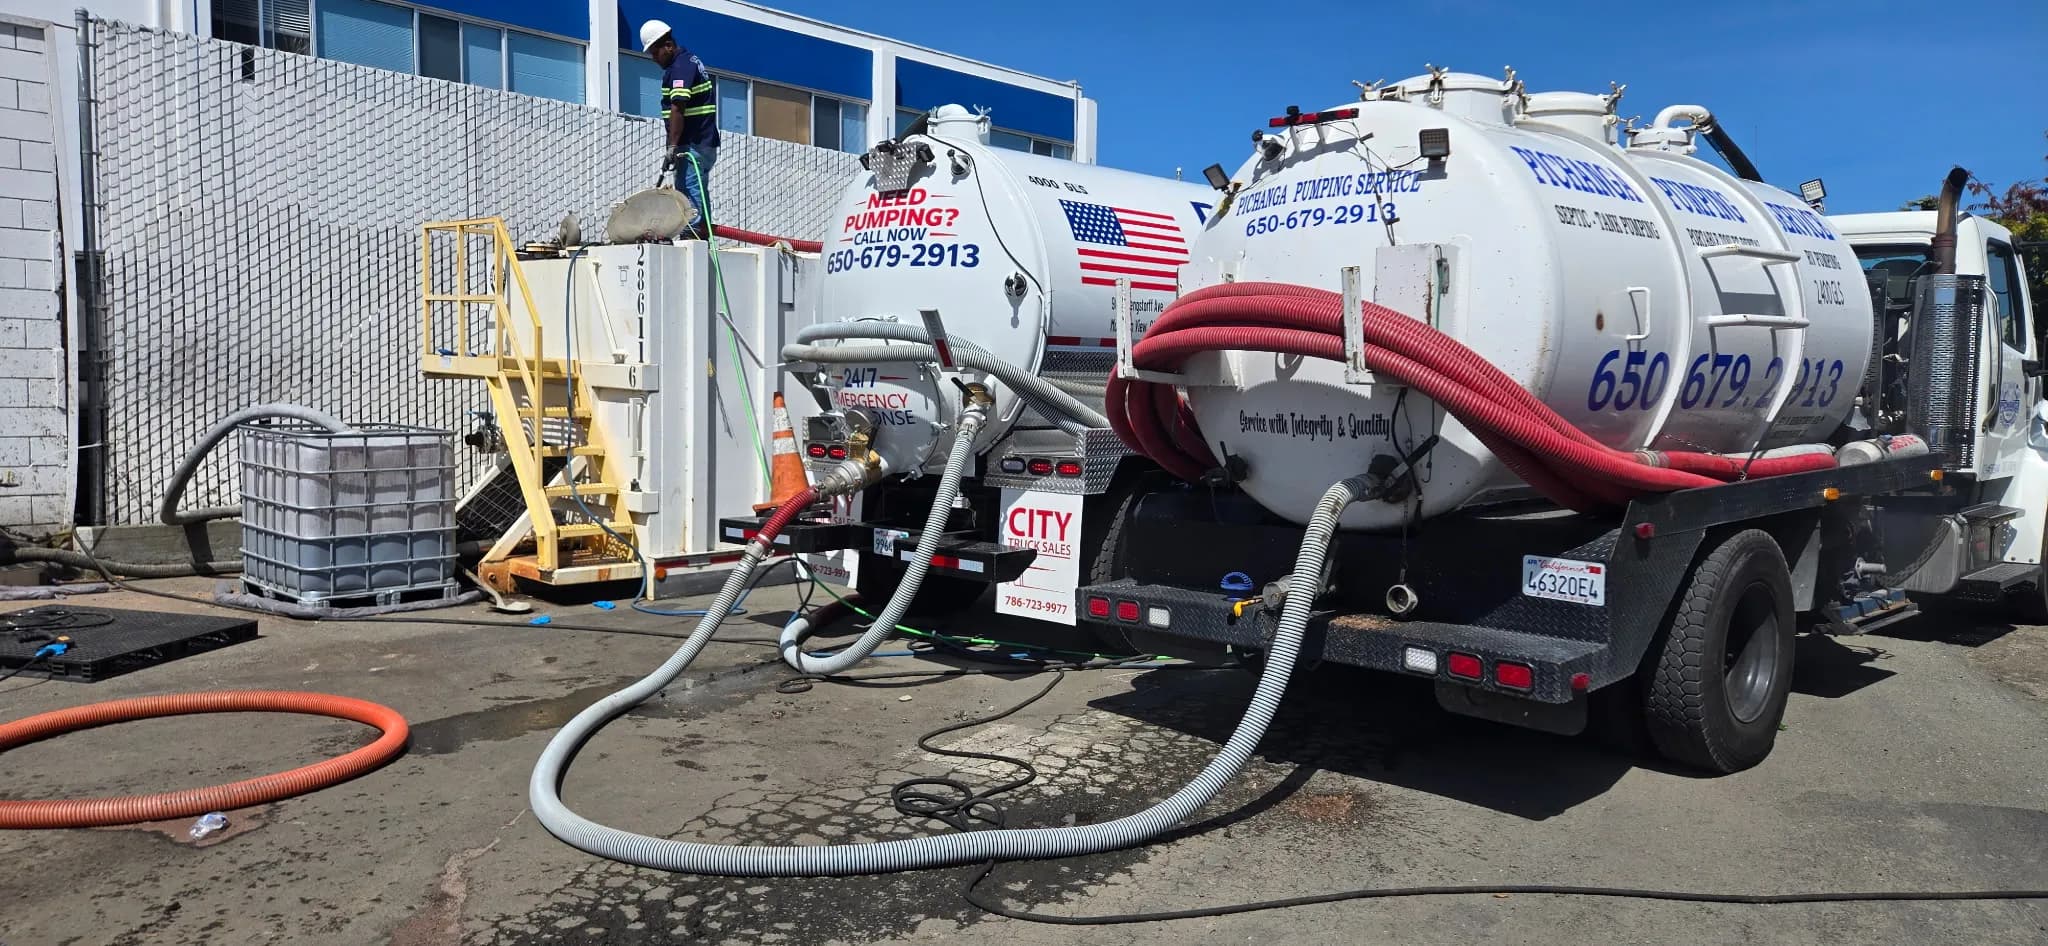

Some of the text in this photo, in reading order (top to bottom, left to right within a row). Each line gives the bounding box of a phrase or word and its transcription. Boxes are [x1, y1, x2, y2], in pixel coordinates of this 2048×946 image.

[1028, 175, 1088, 194] 4000 GLS
[1236, 184, 1288, 216] PICHANGA
[1293, 175, 1352, 202] PUMPING
[1355, 170, 1424, 195] SERVICE
[1510, 145, 1644, 203] PICHANGA
[1649, 176, 1747, 224] PUMPING
[867, 188, 927, 210] NEED
[844, 208, 959, 233] PUMPING?
[1246, 202, 1396, 237] 650-679-2913
[1555, 204, 1592, 228] SEPTIC
[1594, 211, 1623, 234] TANK
[1619, 216, 1660, 240] PUMPING
[854, 227, 927, 245] CALL NOW
[827, 242, 980, 274] 650-679-2913
[1130, 299, 1154, 315] engstorff
[843, 367, 878, 388] 24/7
[1587, 350, 1670, 411] 650
[1239, 409, 1390, 442] Service with Integrity & Quality
[1008, 507, 1073, 541] CITY
[1008, 537, 1071, 556] TRUCK SALES
[1539, 559, 1585, 573] California
[1528, 571, 1598, 599] 46320E4
[1005, 595, 1067, 615] 786-723-9977
